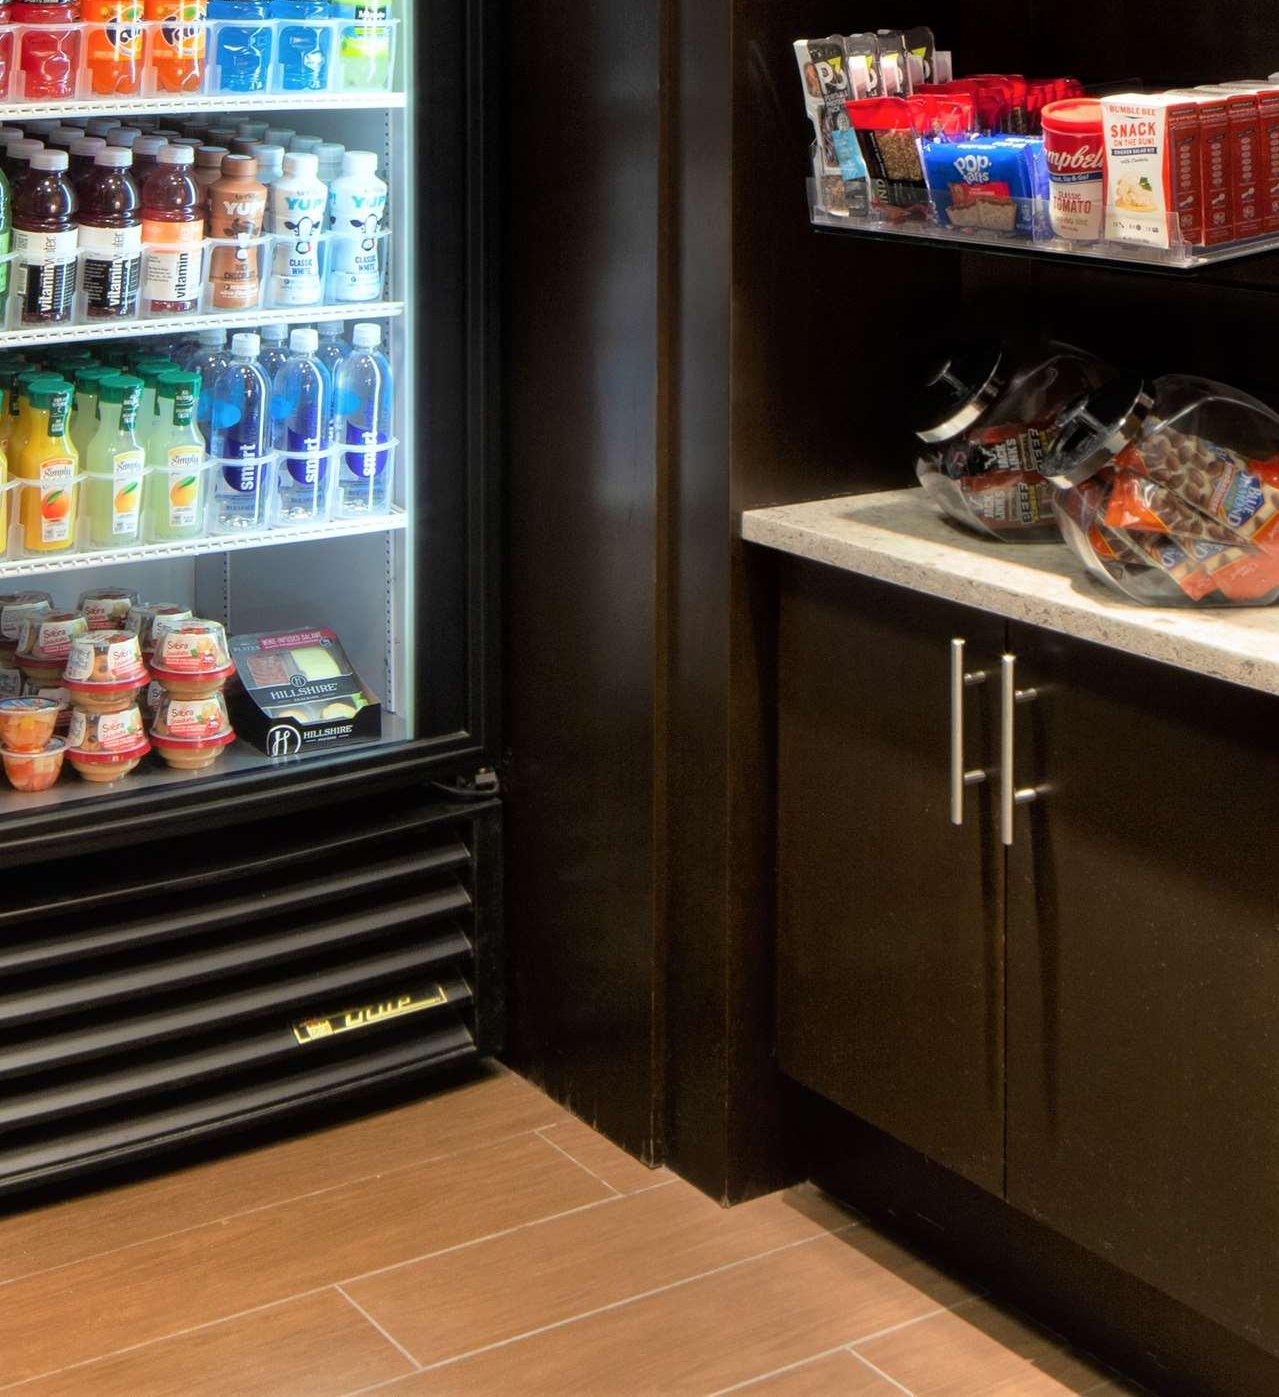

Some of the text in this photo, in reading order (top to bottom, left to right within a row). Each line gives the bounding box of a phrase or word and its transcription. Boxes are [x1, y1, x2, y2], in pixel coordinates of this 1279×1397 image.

[1109, 105, 1156, 116] BUMBLE BEE
[1110, 122, 1156, 138] SNACK
[1114, 138, 1137, 147] ON THE
[1053, 196, 1092, 214] TOMATO
[171, 454, 199, 468] Simply
[43, 467, 71, 479] Simply
[1020, 482, 1032, 523] BEEF
[44, 629, 67, 639] Sabra
[167, 640, 189, 650] Sabra
[270, 682, 339, 700] HILLSHIRE
[303, 725, 354, 739] HILLSHIRE
